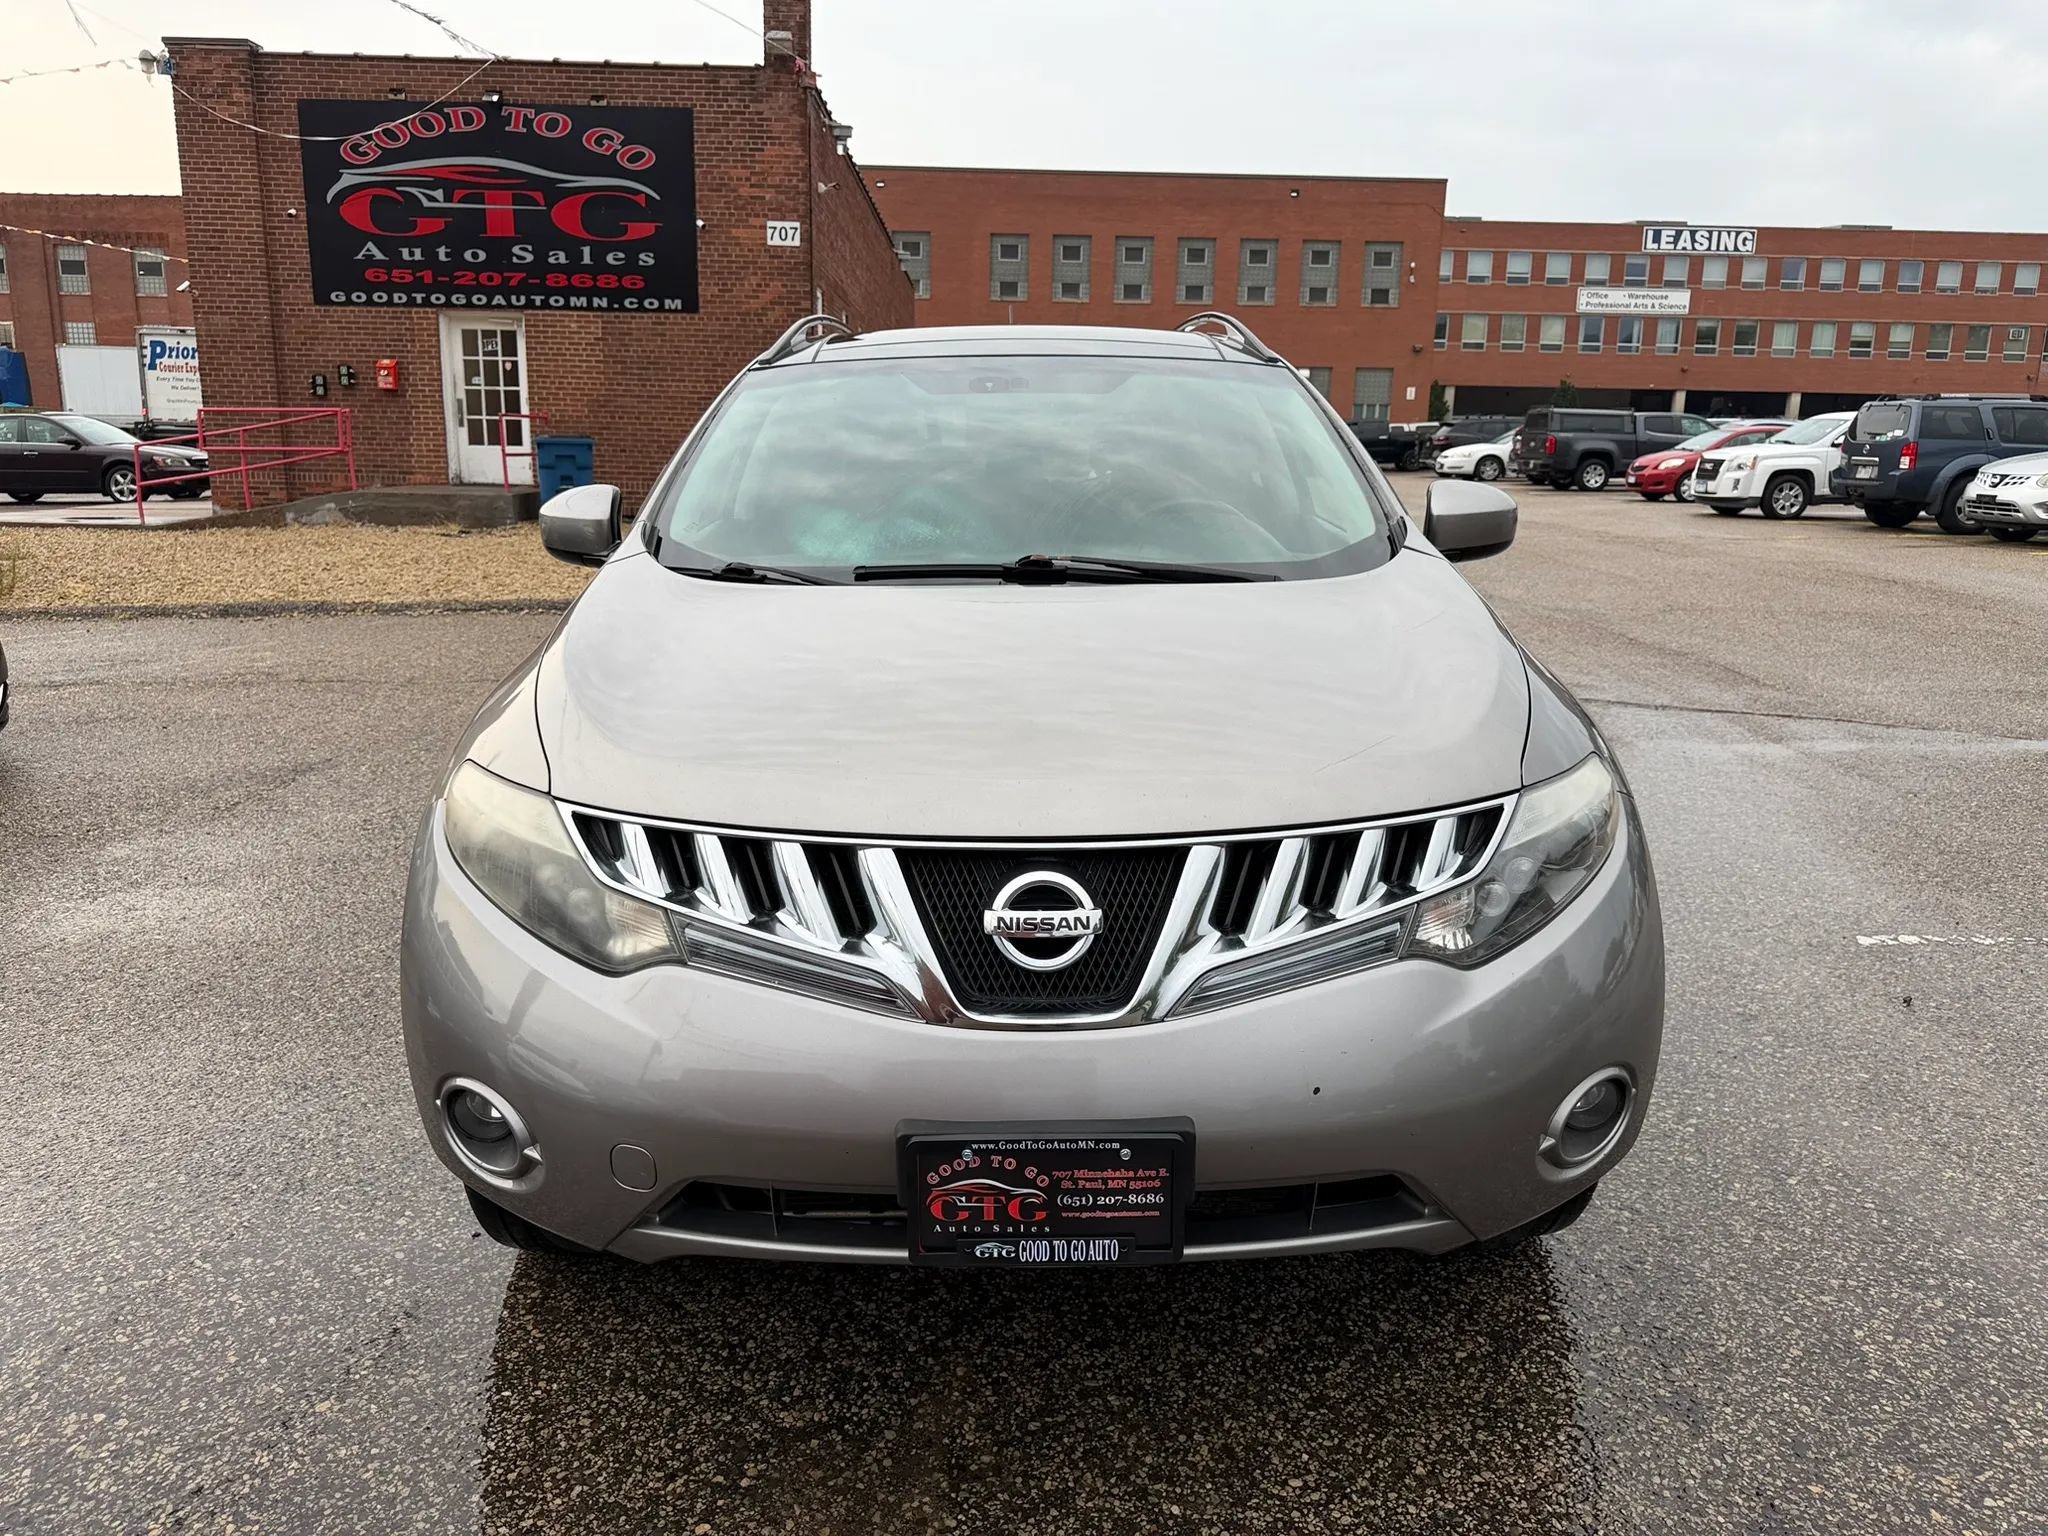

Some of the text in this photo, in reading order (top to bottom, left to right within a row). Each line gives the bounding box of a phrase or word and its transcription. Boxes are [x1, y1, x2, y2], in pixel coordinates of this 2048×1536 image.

[339, 106, 657, 171] GOOD TO GO
[339, 187, 664, 242] GTG
[768, 226, 799, 242] 707
[1645, 229, 1754, 252] LEASING
[353, 240, 656, 267] Auto Sales
[364, 267, 647, 290] 651-207-8686
[329, 291, 683, 311] GOODTOGOAUTOMN.COM
[1586, 291, 1669, 301] Office Warehouse
[1585, 301, 1632, 310] Professional
[1633, 302, 1649, 311] Arts
[1658, 303, 1687, 312] Science
[159, 361, 184, 373] Courier
[996, 915, 1091, 932] NISSAN
[971, 1140, 1121, 1151] www.GoodToGoAutoMN.com
[926, 1155, 1050, 1188] GOOD TO GO
[1052, 1168, 1170, 1180] 707 Minnehaha Ave E.
[1060, 1179, 1161, 1190] St. Paul, MN 55106
[1057, 1192, 1165, 1207] (651) 207-8686
[929, 1195, 1048, 1222] GTG
[933, 1224, 1051, 1233] Auto Sales
[974, 1248, 1017, 1258] GTG
[1018, 1239, 1119, 1263] GOOD TO GO AUTO
